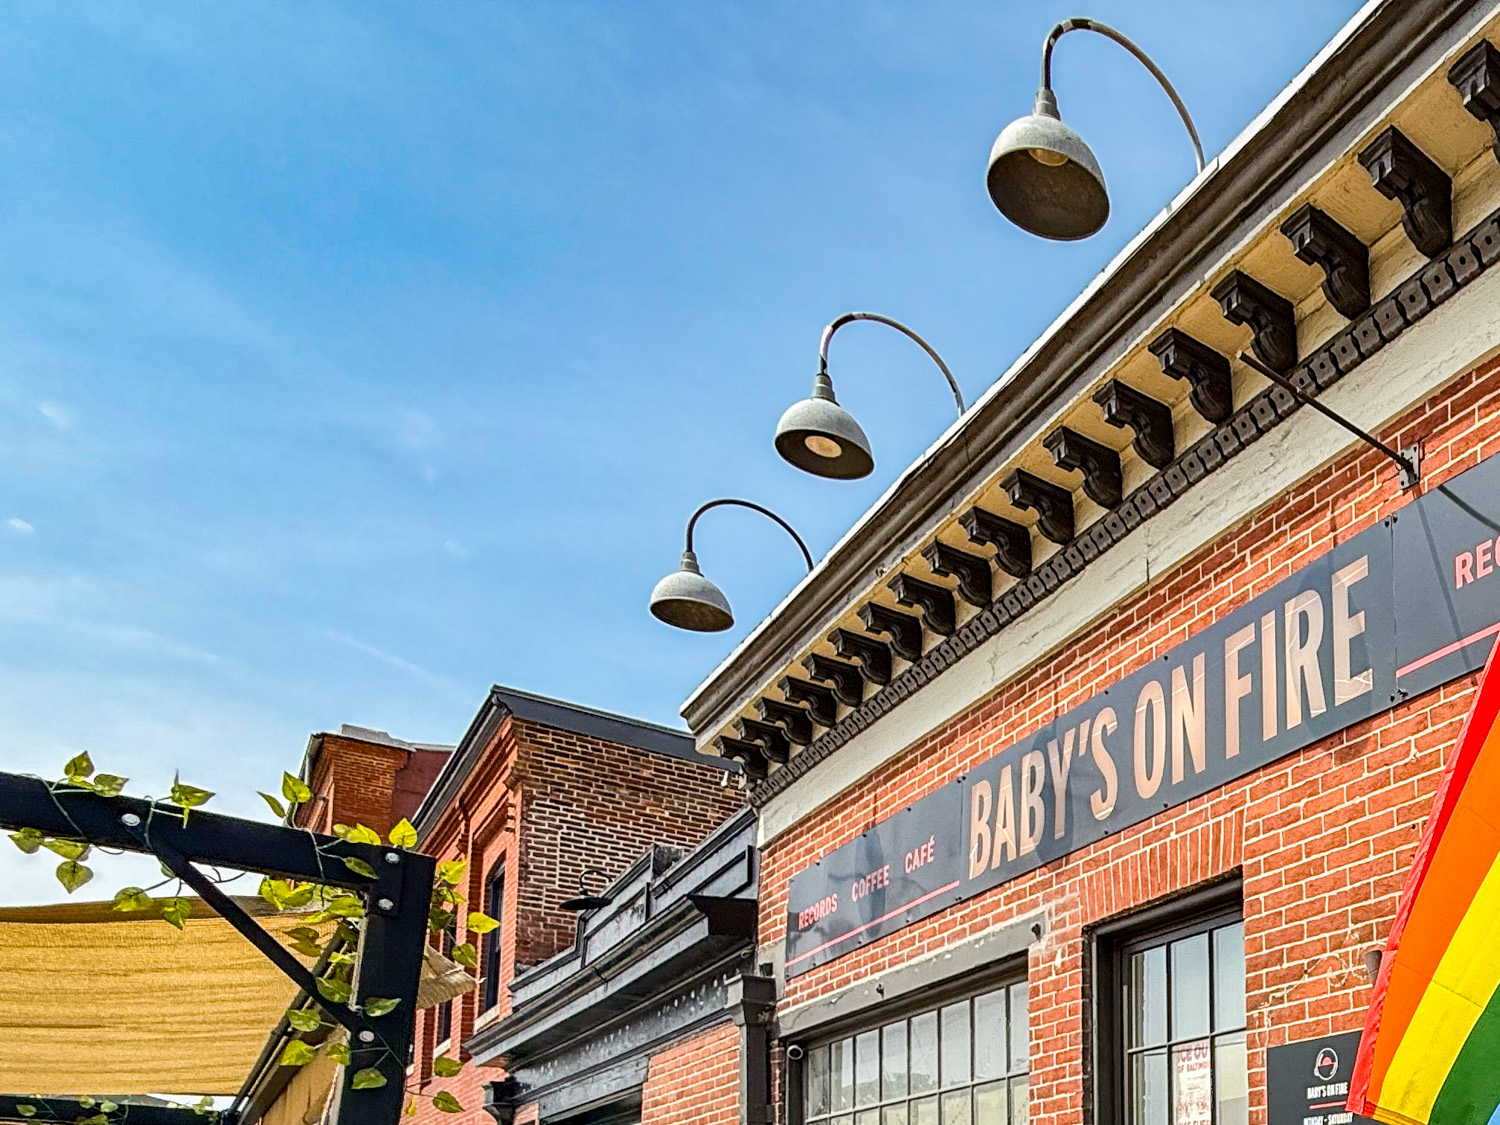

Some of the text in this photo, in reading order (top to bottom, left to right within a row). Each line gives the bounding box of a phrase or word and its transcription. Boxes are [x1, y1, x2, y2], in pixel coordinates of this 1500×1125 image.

[968, 554, 1374, 880] BABY'S ON FIRE
[798, 835, 935, 931] RECORDS COFFEE CAFÉ
[1307, 1082, 1348, 1099] BABY'S ON FIRE
[1328, 1112, 1353, 1125] SATURDAY
